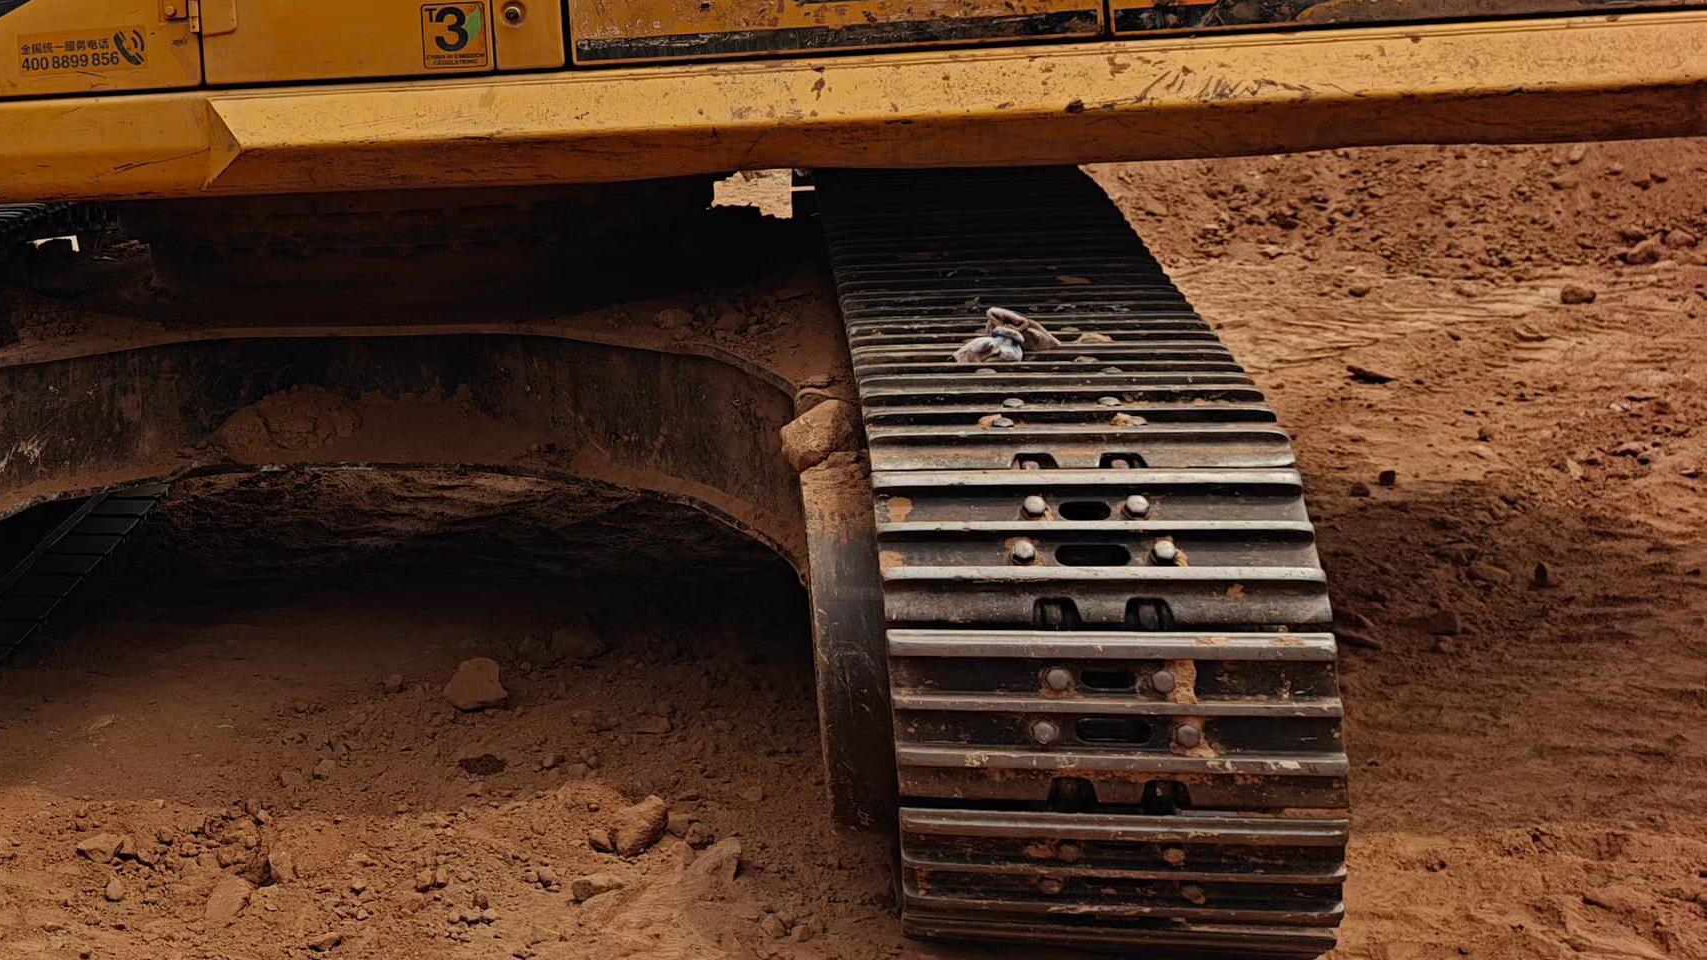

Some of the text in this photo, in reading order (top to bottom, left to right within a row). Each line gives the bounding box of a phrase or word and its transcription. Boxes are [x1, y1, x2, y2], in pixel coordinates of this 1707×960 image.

[21, 38, 109, 55] 全国统一服务电话
[22, 51, 120, 71] 400 8899 856
